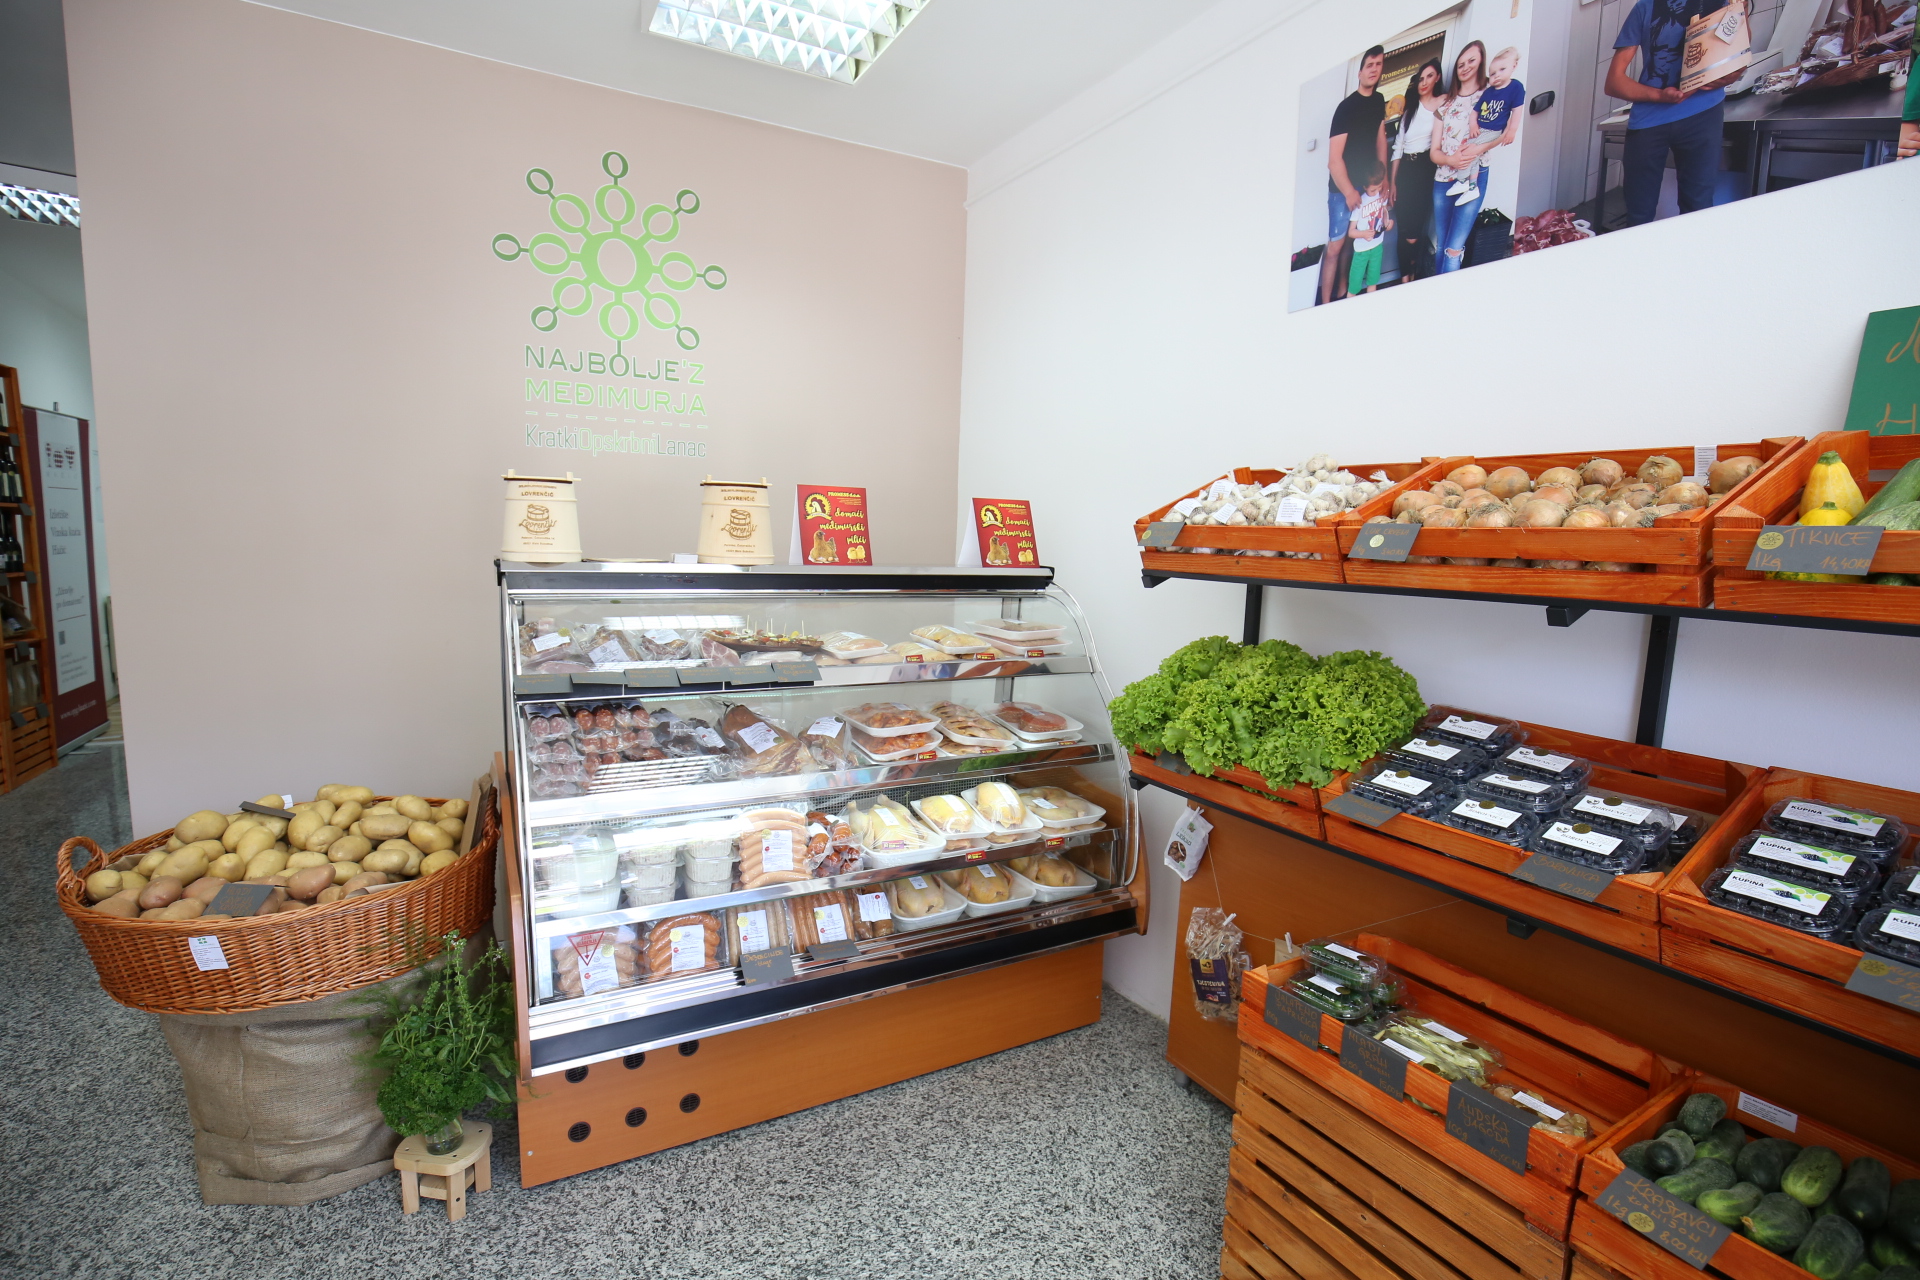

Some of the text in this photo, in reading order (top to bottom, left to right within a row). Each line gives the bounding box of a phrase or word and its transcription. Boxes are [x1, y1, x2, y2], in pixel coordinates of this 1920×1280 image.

[1381, 67, 1407, 80] Promess
[525, 378, 707, 416] MEĐIMURJA
[834, 507, 865, 519] domaći
[1005, 516, 1031, 527] domaći
[1783, 526, 1875, 548] TIKVICE
[1791, 804, 1823, 815] KUPINA
[1759, 840, 1792, 852] KUPINA
[1732, 875, 1764, 888] KUPINA
[1625, 1178, 1718, 1238] KRASTAVCI
